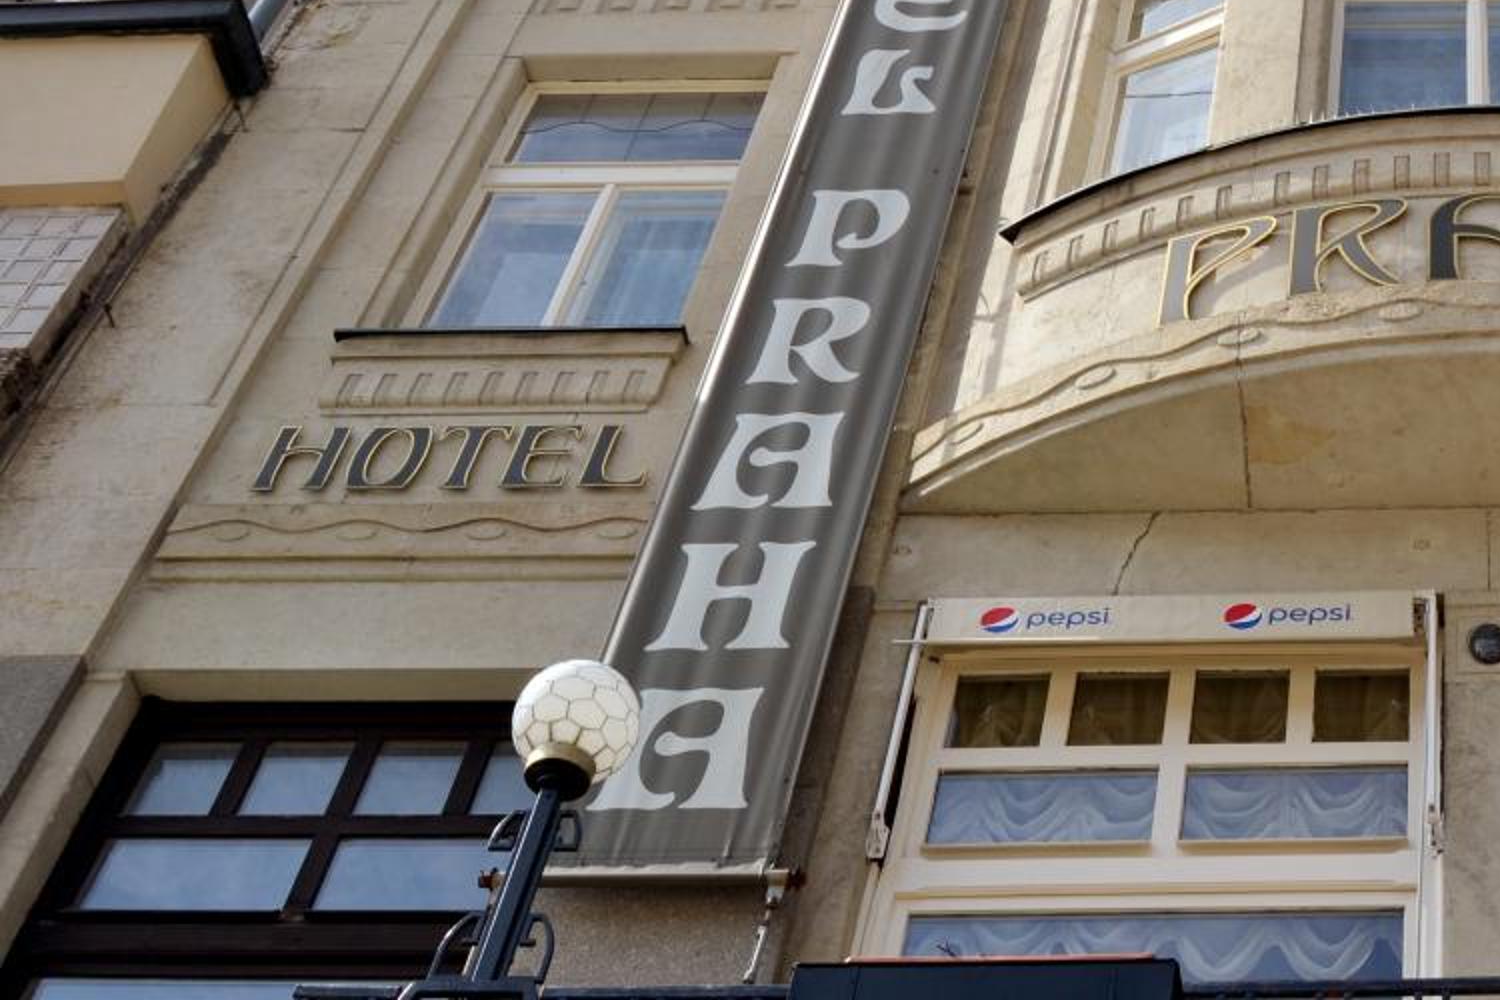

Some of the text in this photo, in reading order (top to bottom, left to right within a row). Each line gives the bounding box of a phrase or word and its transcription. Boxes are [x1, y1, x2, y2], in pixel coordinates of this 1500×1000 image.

[251, 423, 648, 493] HOTEL
[585, 189, 911, 810] PRAHA
[1026, 606, 1110, 629] pepsi
[1268, 603, 1352, 626] pepsi
